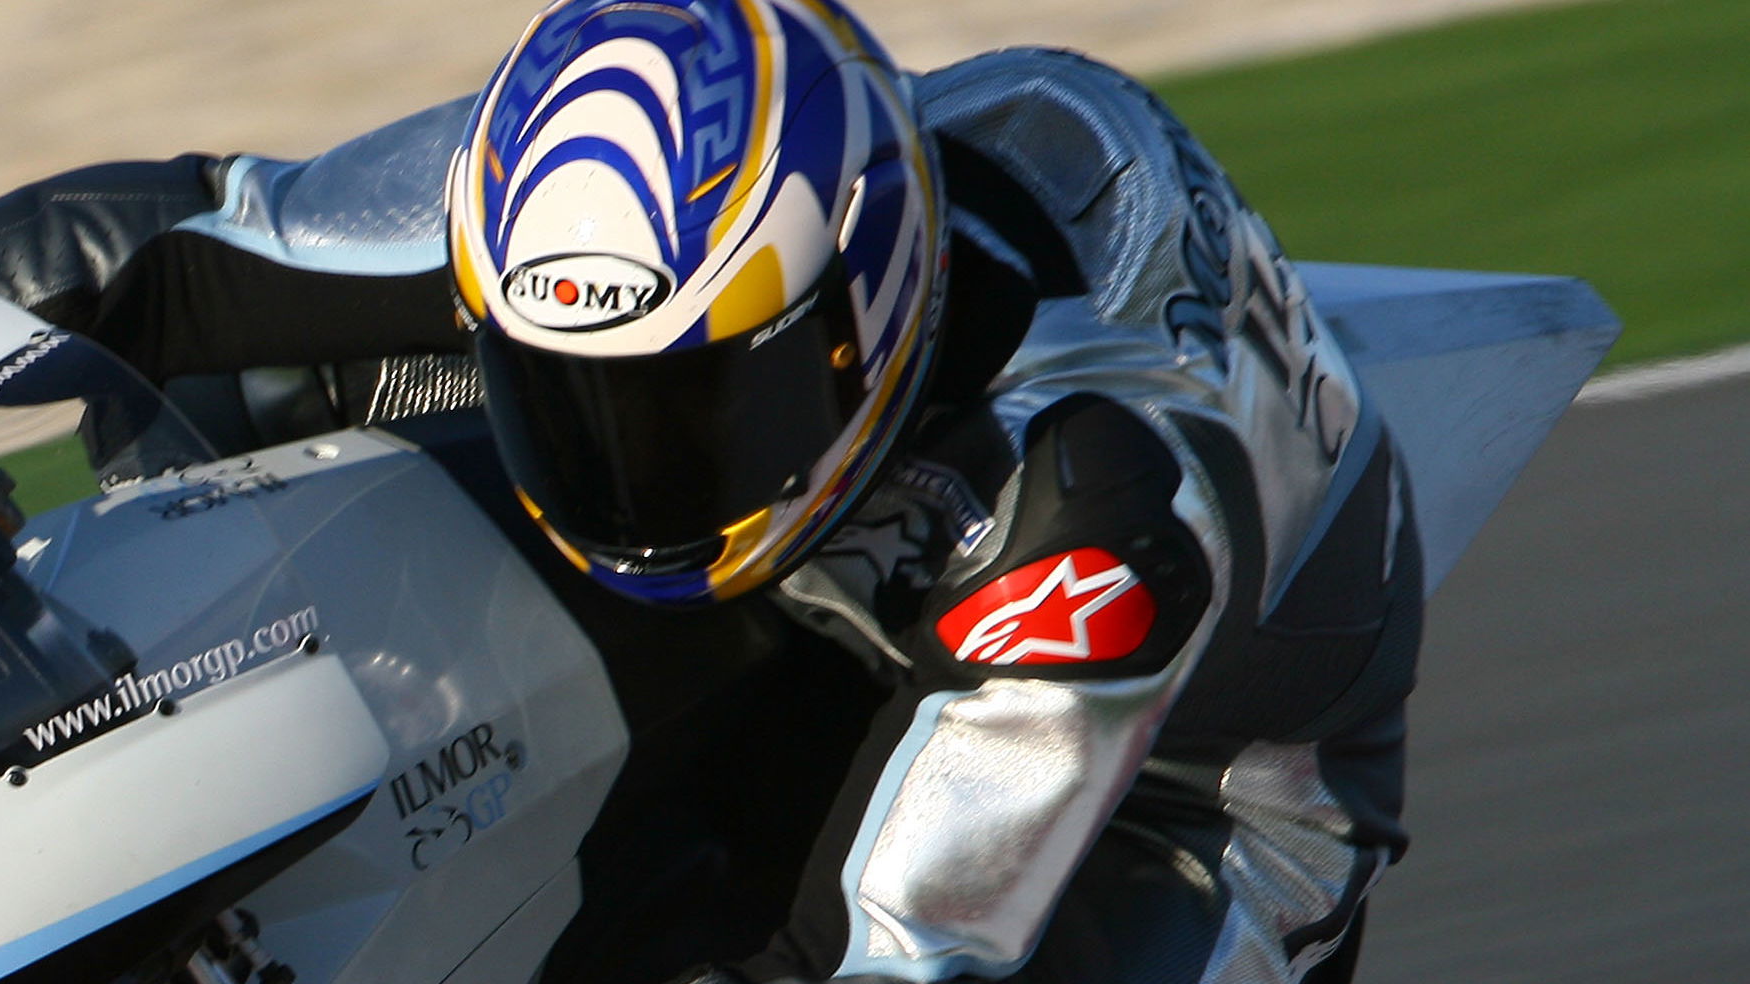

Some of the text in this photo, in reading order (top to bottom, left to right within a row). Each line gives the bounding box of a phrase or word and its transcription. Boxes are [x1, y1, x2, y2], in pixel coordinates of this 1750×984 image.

[510, 265, 654, 317] SUOMY
[23, 604, 320, 751] www.ilmorgp.com
[389, 722, 502, 820] ILMOR
[465, 772, 512, 830] GP
